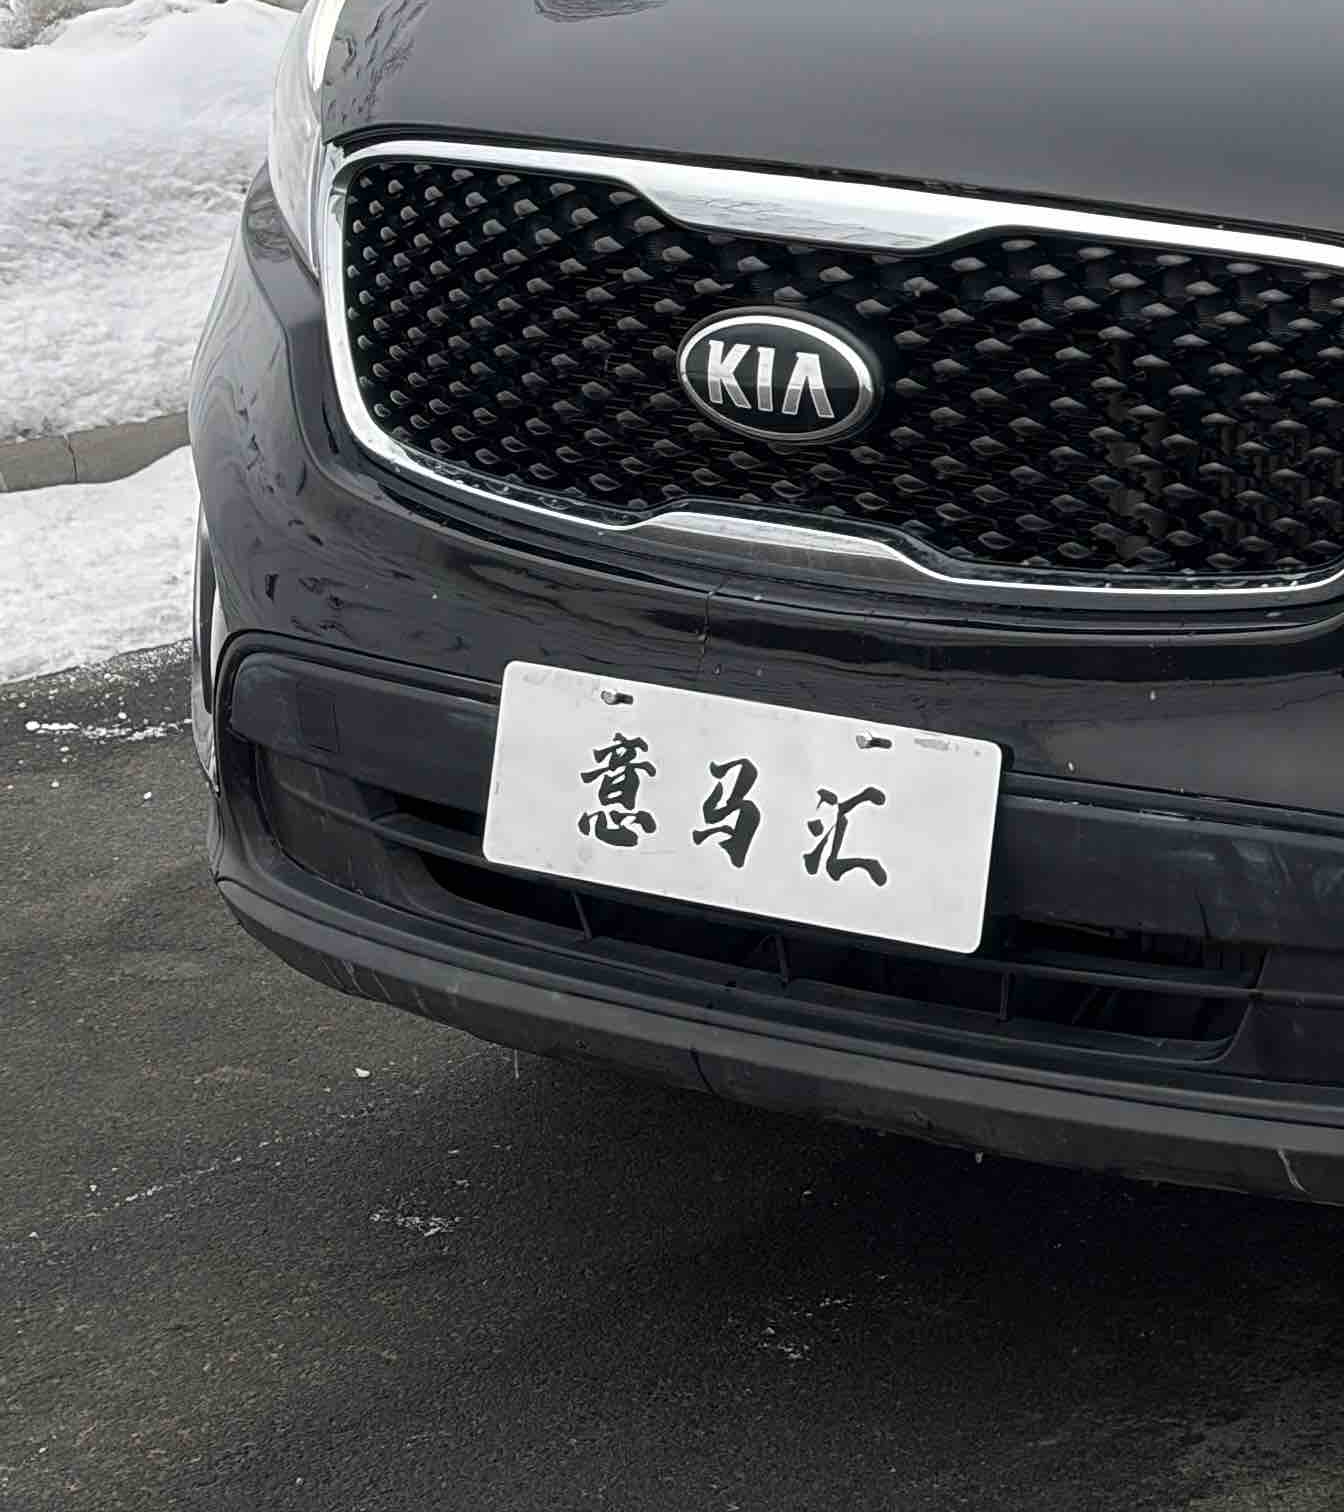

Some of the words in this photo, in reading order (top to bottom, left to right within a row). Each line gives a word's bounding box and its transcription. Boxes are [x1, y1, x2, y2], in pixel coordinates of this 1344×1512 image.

[707, 339, 836, 419] KIA
[577, 732, 888, 887] 意马汇
